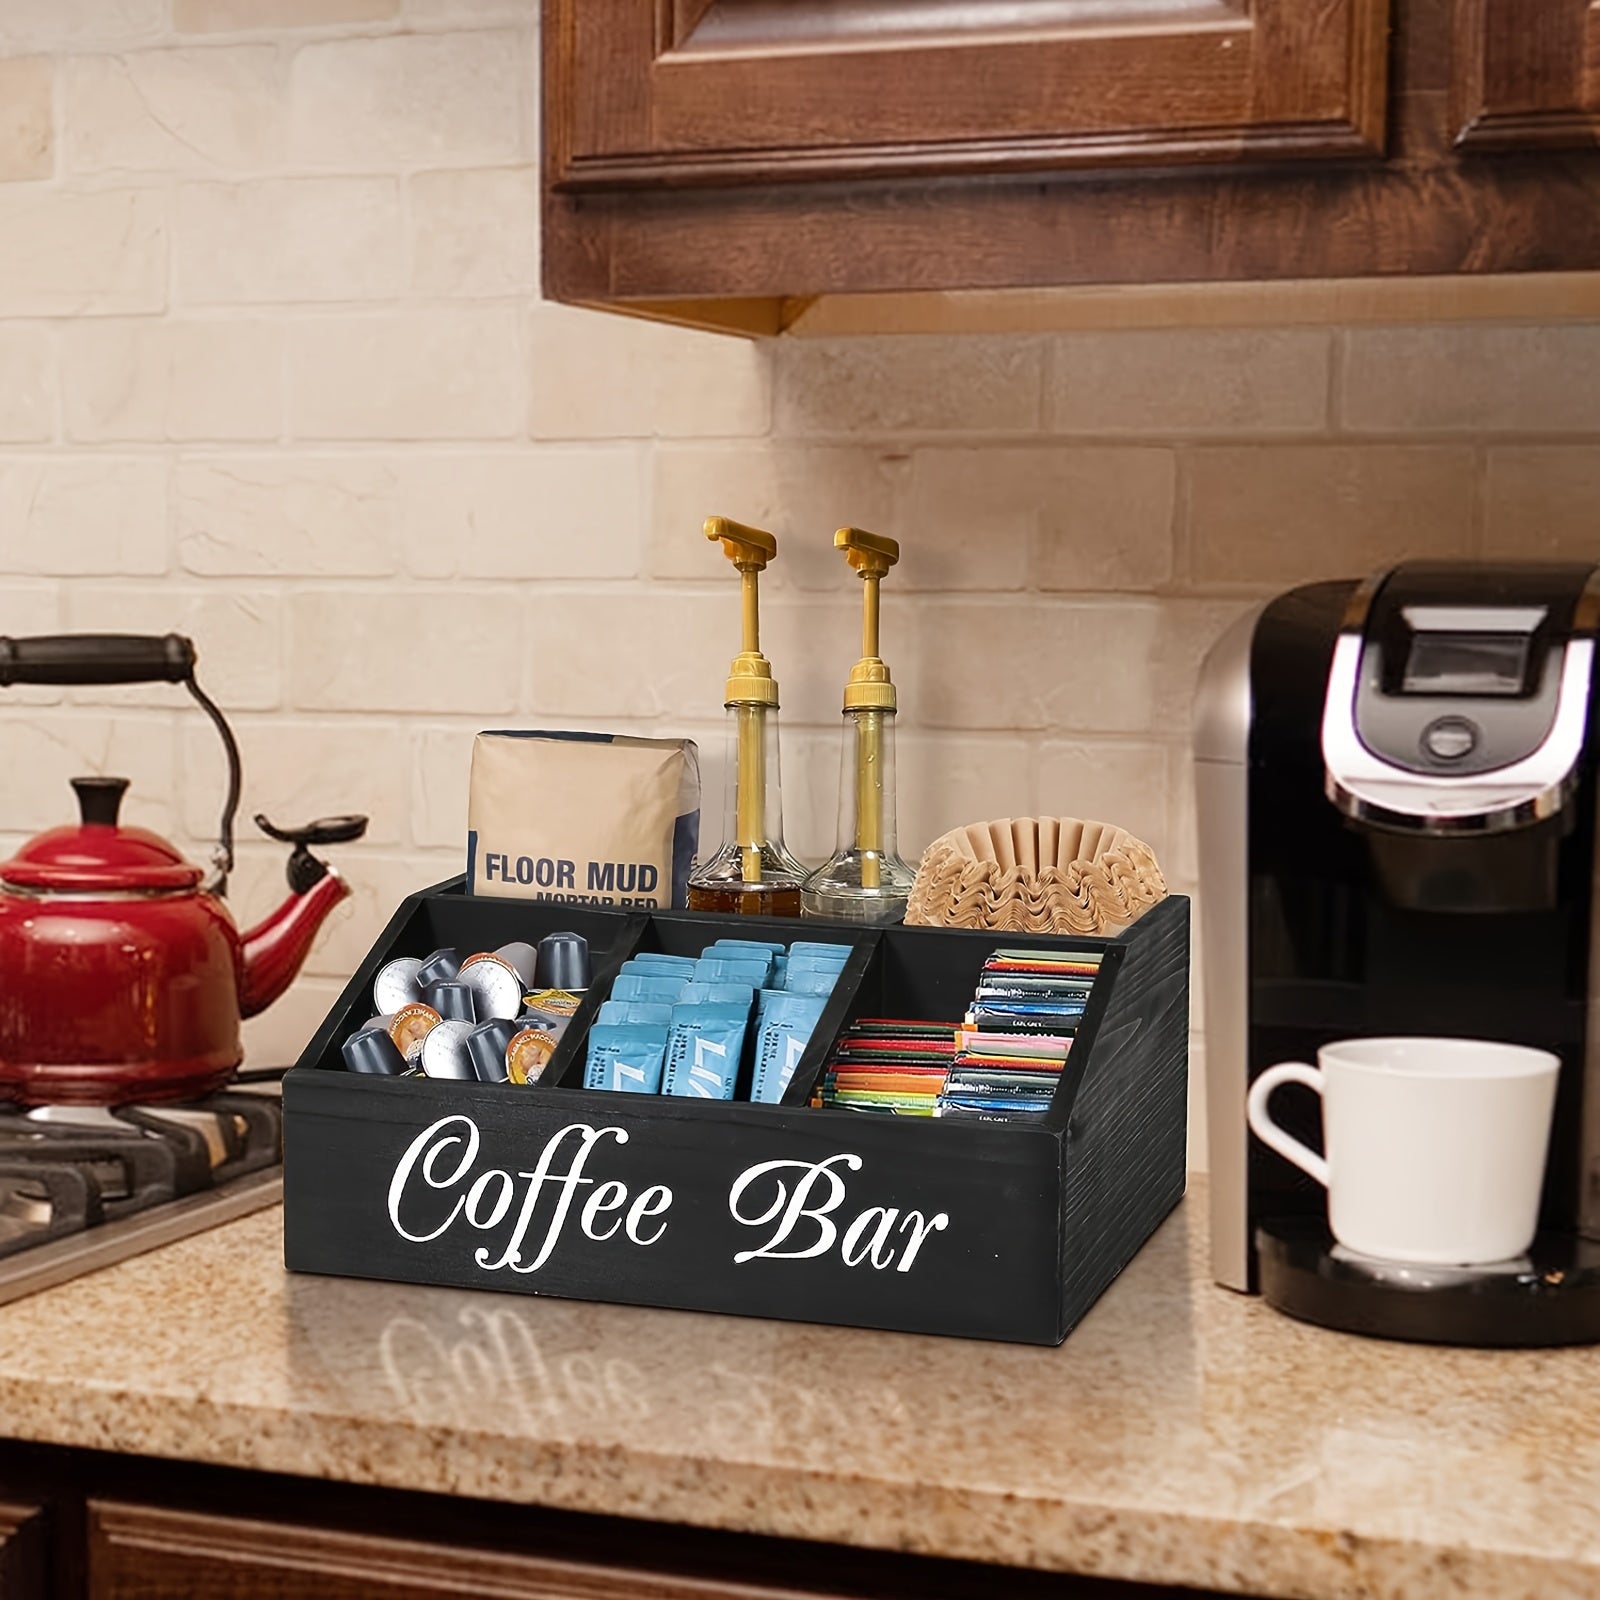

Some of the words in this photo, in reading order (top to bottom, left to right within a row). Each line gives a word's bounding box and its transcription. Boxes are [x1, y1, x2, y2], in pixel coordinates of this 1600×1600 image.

[486, 853, 575, 889] FLOOR
[587, 861, 658, 893] MUD
[388, 1115, 672, 1273] Coffee
[729, 1154, 948, 1272] Bar
